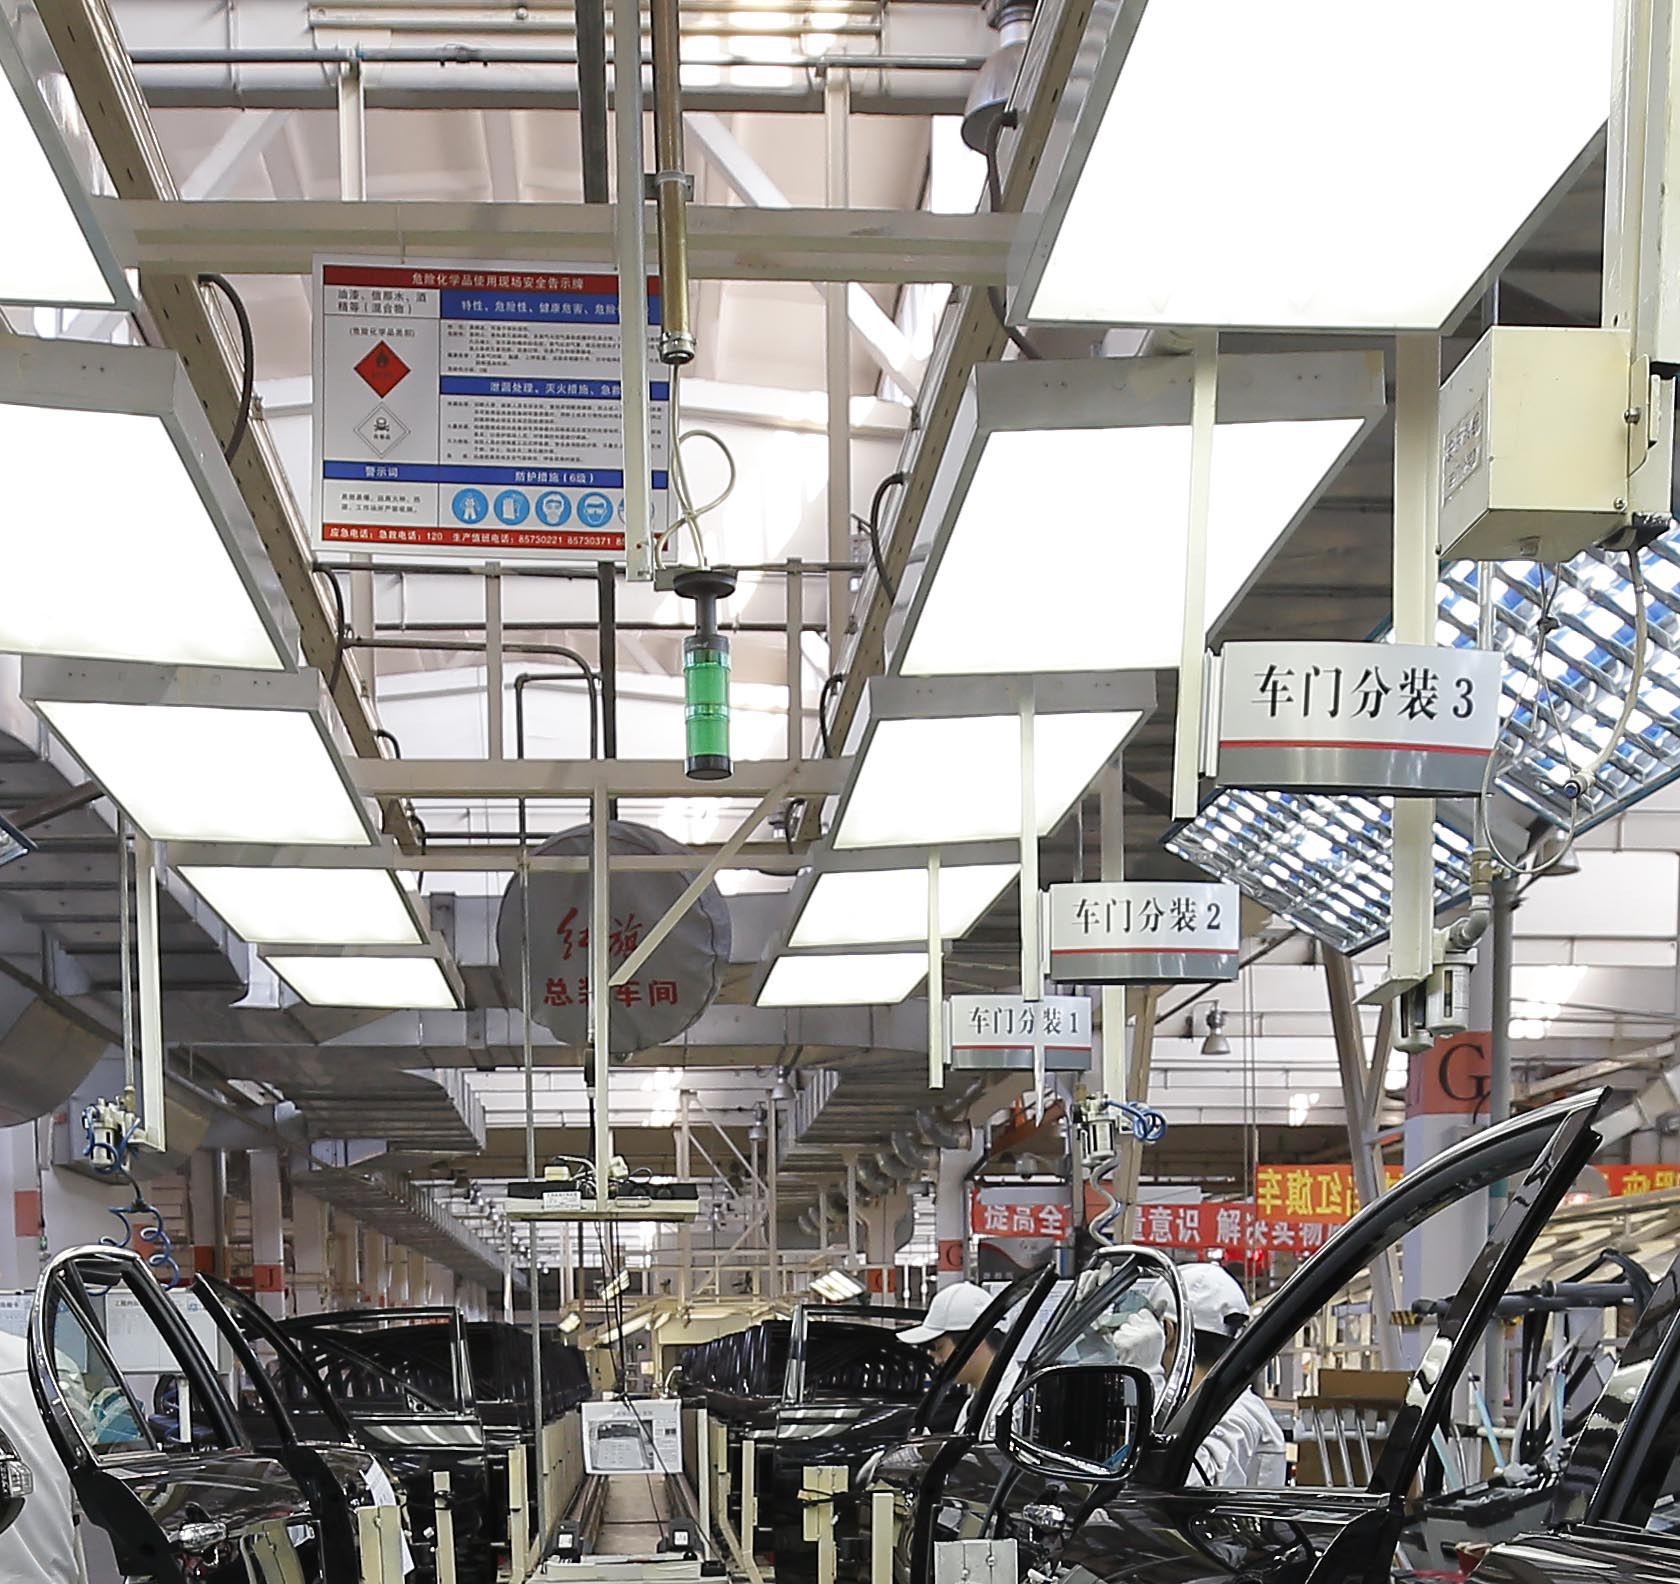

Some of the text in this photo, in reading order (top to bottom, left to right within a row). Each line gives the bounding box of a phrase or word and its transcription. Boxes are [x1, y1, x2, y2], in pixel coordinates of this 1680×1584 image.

[411, 272, 584, 291] 危险化学品使用现场安全告示牌
[461, 300, 620, 316] 特性、危险性、健康危害、危险
[365, 465, 399, 478] 警示词
[1251, 664, 1475, 722] 车门分装3
[1072, 896, 1222, 934] 车门分装2
